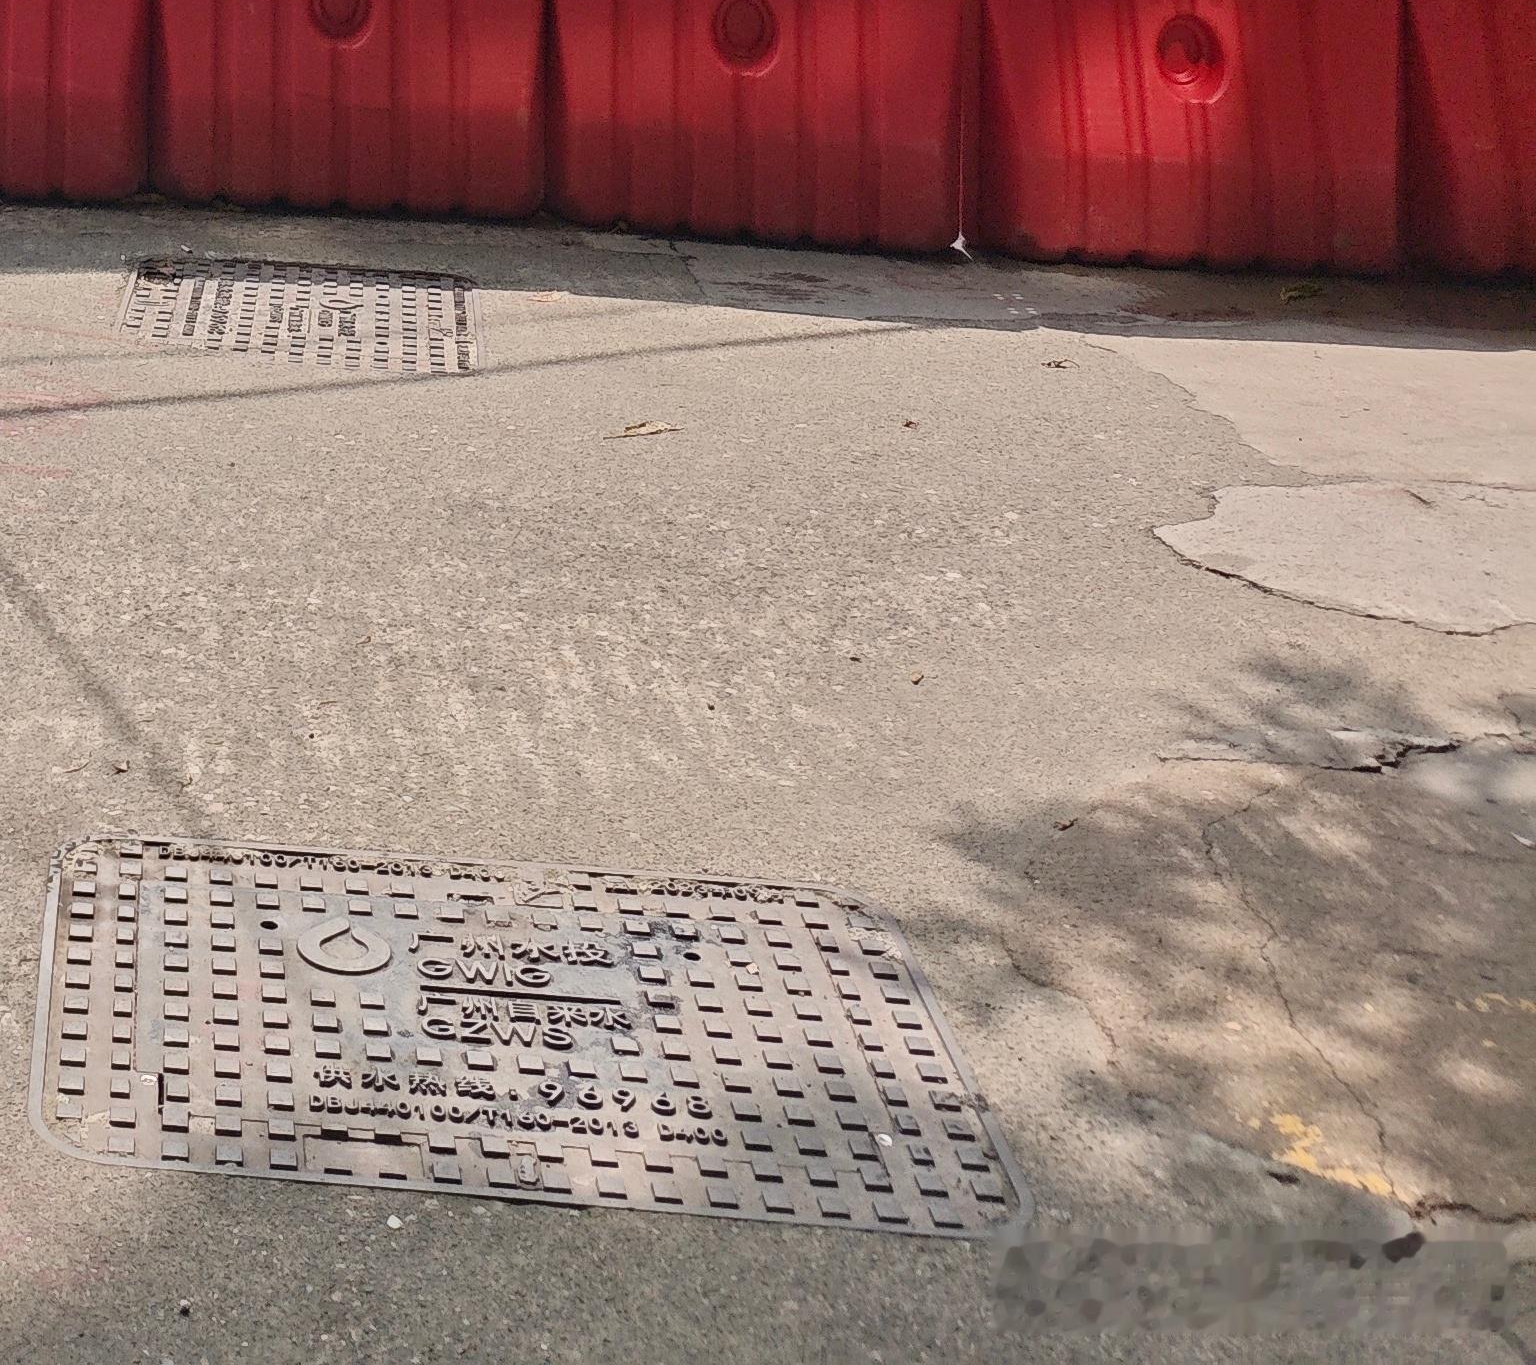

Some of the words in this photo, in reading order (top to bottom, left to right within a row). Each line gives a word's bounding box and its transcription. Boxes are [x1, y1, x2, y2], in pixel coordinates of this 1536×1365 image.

[408, 930, 615, 967] 广州水投
[416, 957, 553, 988] GWIG
[417, 992, 633, 1030] 广州自来水
[421, 1016, 574, 1051] GZWS
[308, 1092, 641, 1139] DBJ440100/T160-2013
[657, 1122, 730, 1146] D400
